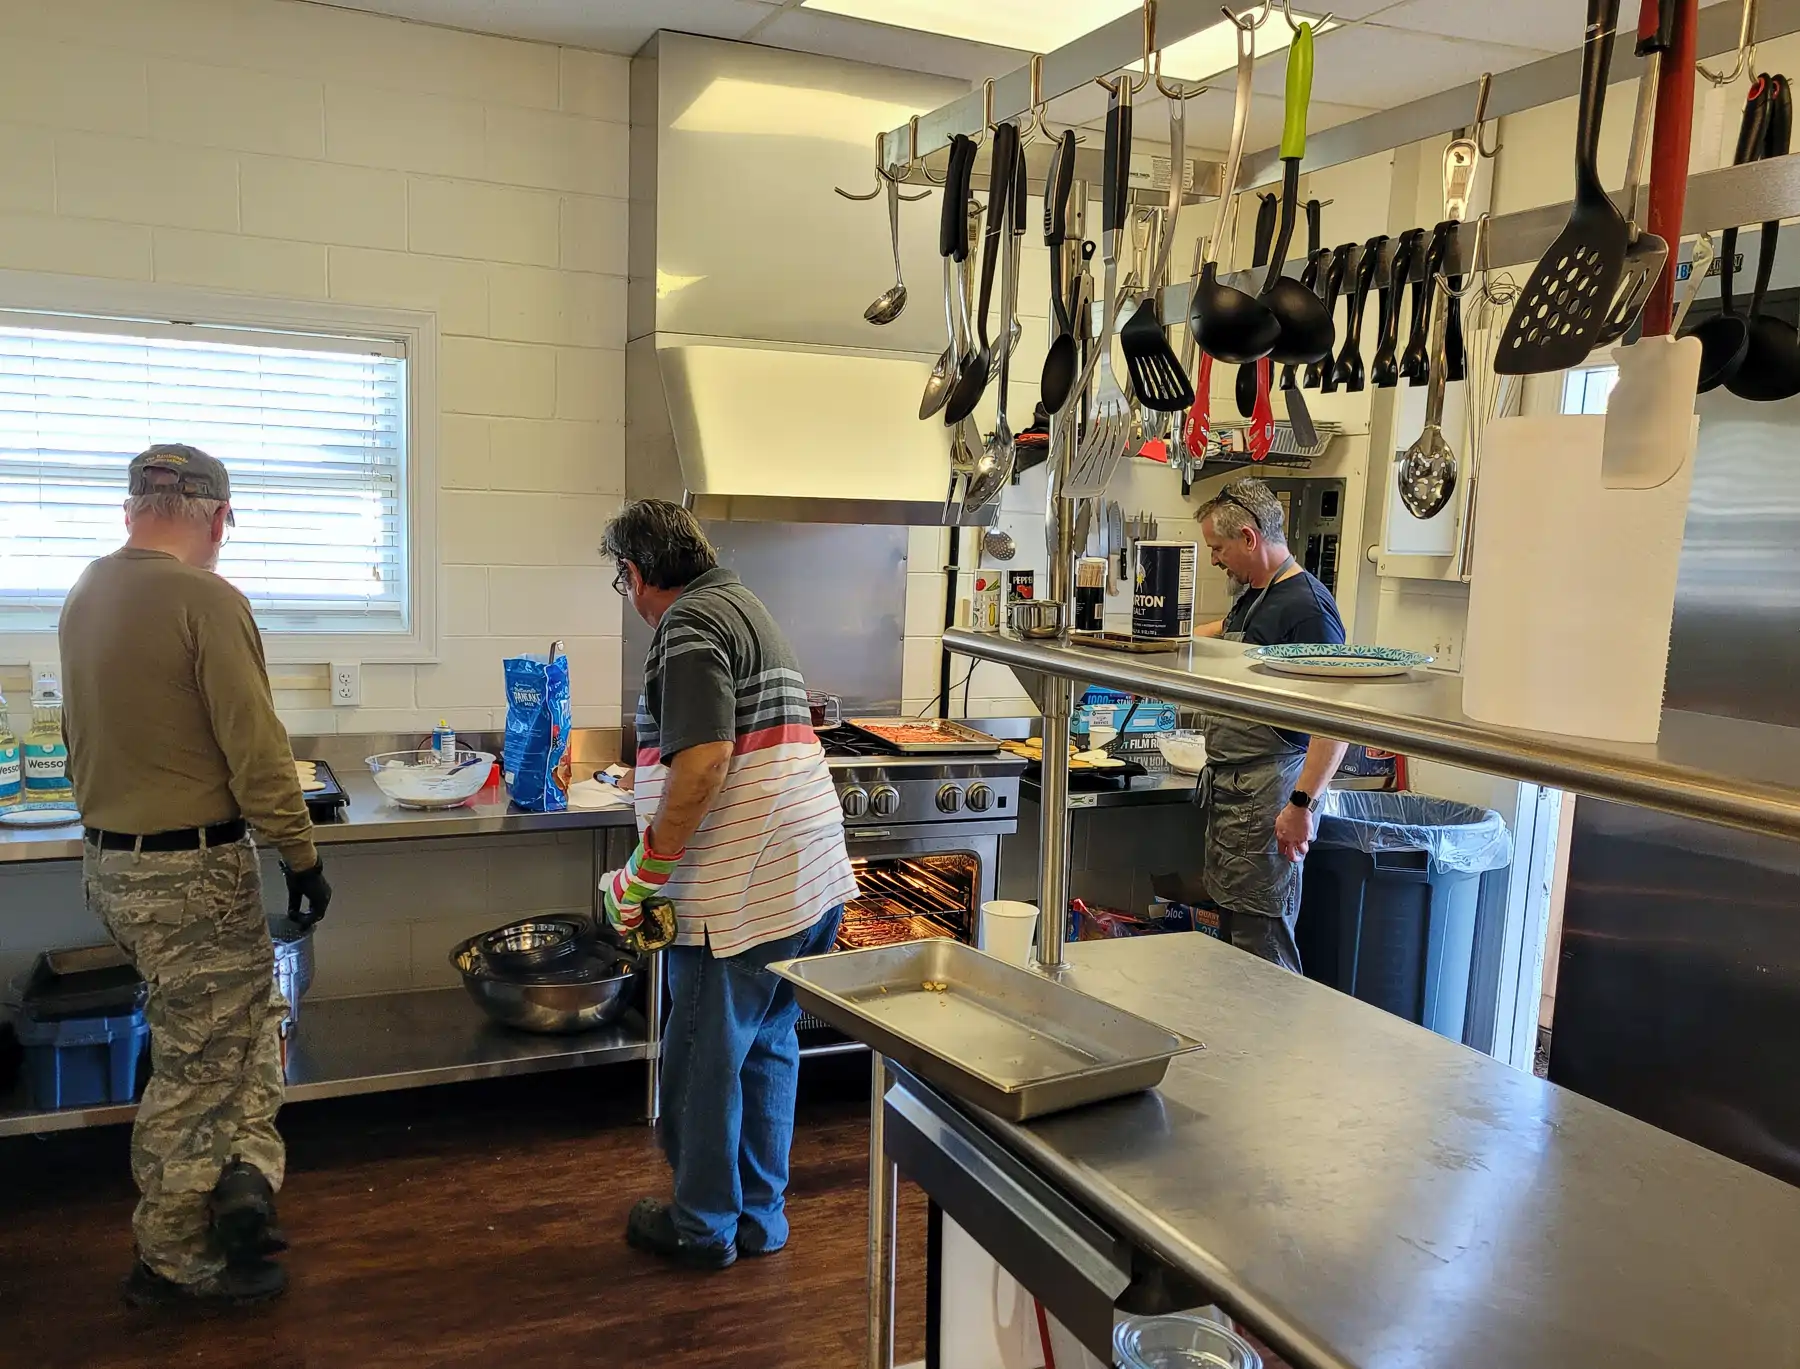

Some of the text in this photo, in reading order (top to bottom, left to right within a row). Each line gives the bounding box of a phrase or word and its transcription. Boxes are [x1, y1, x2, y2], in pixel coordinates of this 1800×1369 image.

[1012, 576, 1033, 584] PEPPE
[1133, 594, 1164, 608] RTON
[1130, 739, 1149, 749] FILM
